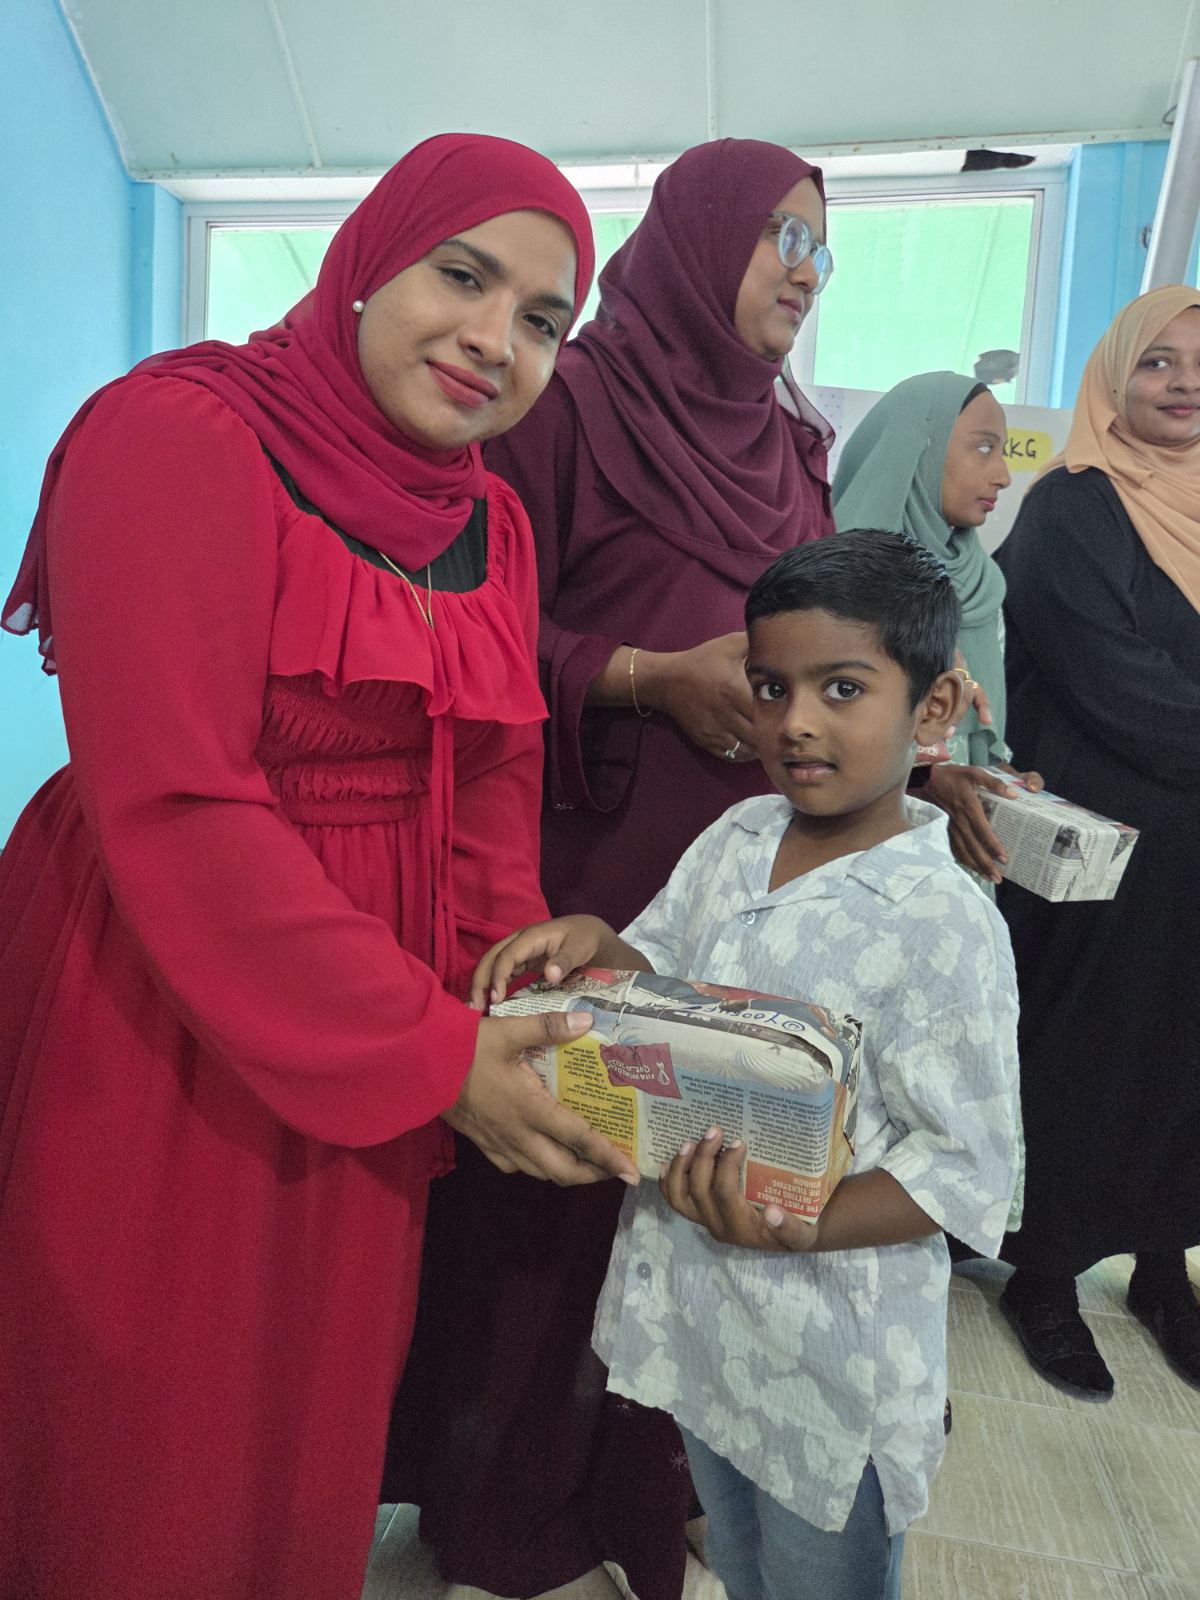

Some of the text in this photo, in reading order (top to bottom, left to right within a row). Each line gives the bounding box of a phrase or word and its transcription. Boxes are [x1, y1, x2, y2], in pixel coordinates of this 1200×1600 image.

[764, 1185, 781, 1195] PAST
[772, 1180, 806, 1195] TICKETING
[756, 1192, 818, 1213] THE FIRST HURDLE
[782, 1191, 811, 1203] GETTING
